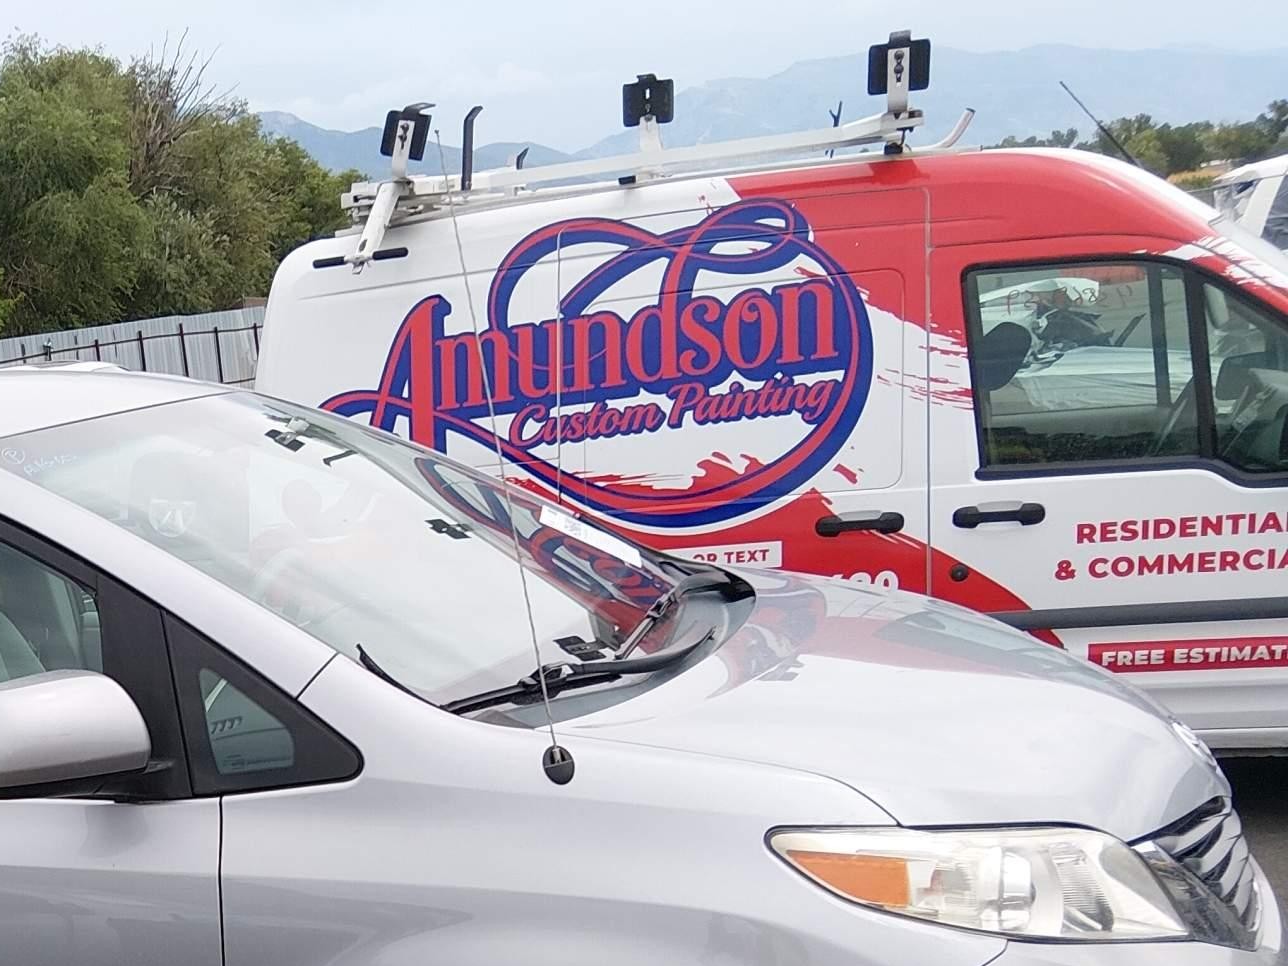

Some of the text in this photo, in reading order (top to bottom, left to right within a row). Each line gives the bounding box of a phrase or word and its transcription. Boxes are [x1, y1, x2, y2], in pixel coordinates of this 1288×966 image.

[367, 281, 841, 452] Amundson
[509, 378, 840, 449] Custom Painting
[1076, 511, 1288, 544] RESIDENTIA
[724, 549, 769, 563] TEXT
[1055, 559, 1076, 581] &
[1102, 644, 1288, 667] FREE ESTIMAT
